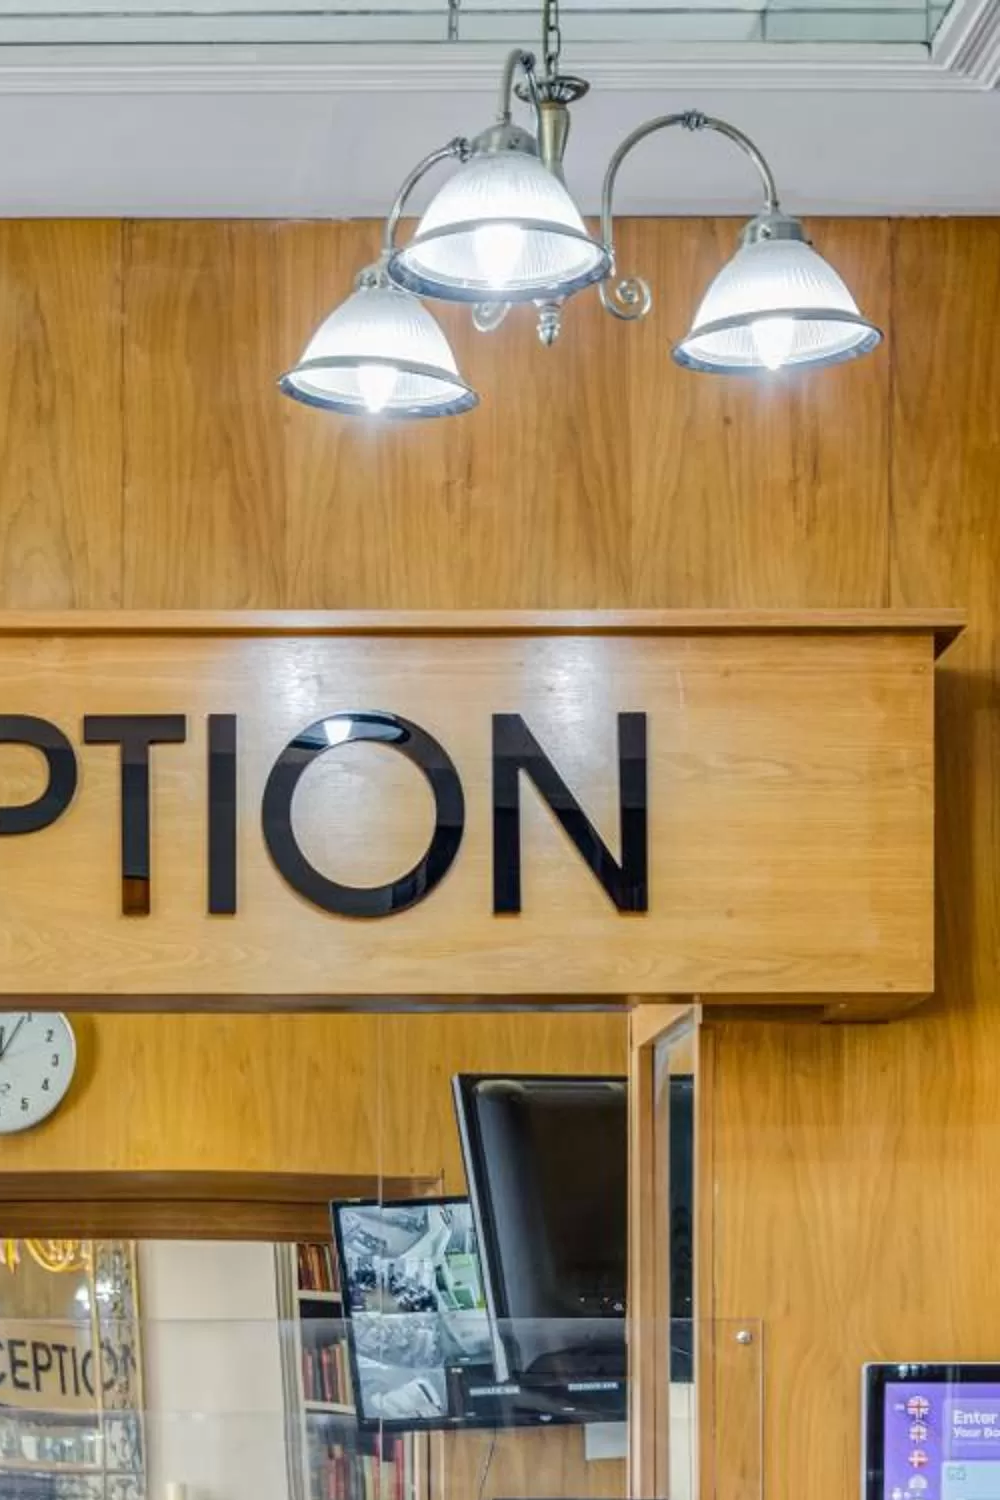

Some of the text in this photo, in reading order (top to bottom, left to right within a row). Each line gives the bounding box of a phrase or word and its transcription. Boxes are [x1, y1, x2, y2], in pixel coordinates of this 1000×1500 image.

[45, 1029, 55, 1043] 2
[51, 1053, 60, 1067] 3
[41, 1077, 50, 1091] 4
[20, 1097, 30, 1111] 5
[952, 1410, 998, 1425] Enter
[952, 1427, 981, 1439] Your
